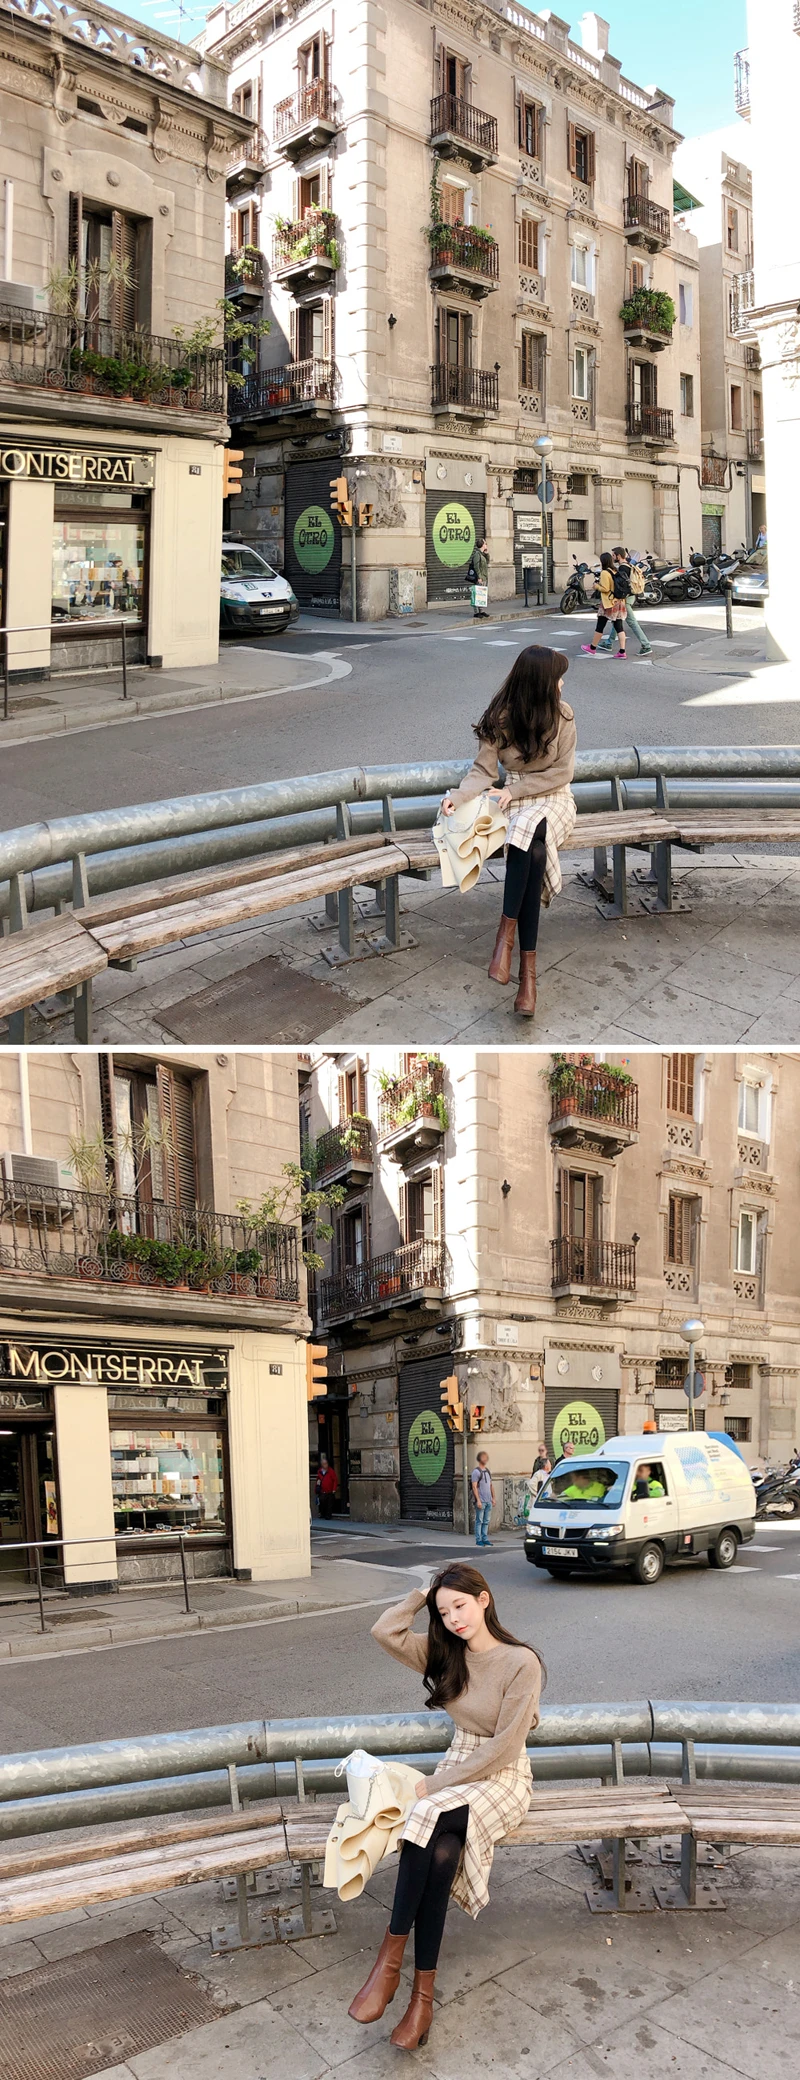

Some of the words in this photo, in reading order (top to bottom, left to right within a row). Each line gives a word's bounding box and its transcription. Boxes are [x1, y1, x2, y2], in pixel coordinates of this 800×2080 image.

[0, 449, 136, 482] ONTSERRAT
[308, 516, 322, 528] EL
[446, 512, 461, 525] EL
[298, 529, 328, 547] OTRO
[439, 525, 470, 544] OTRO
[9, 1348, 204, 1384] MONTSERRAT
[271, 1364, 280, 1375] 81
[567, 1412, 587, 1426] EL
[421, 1422, 435, 1435] EL
[560, 1427, 599, 1447] OTRO
[413, 1436, 441, 1457] OTRO
[546, 1546, 562, 1556] 2154
[564, 1548, 577, 1557] JKV
